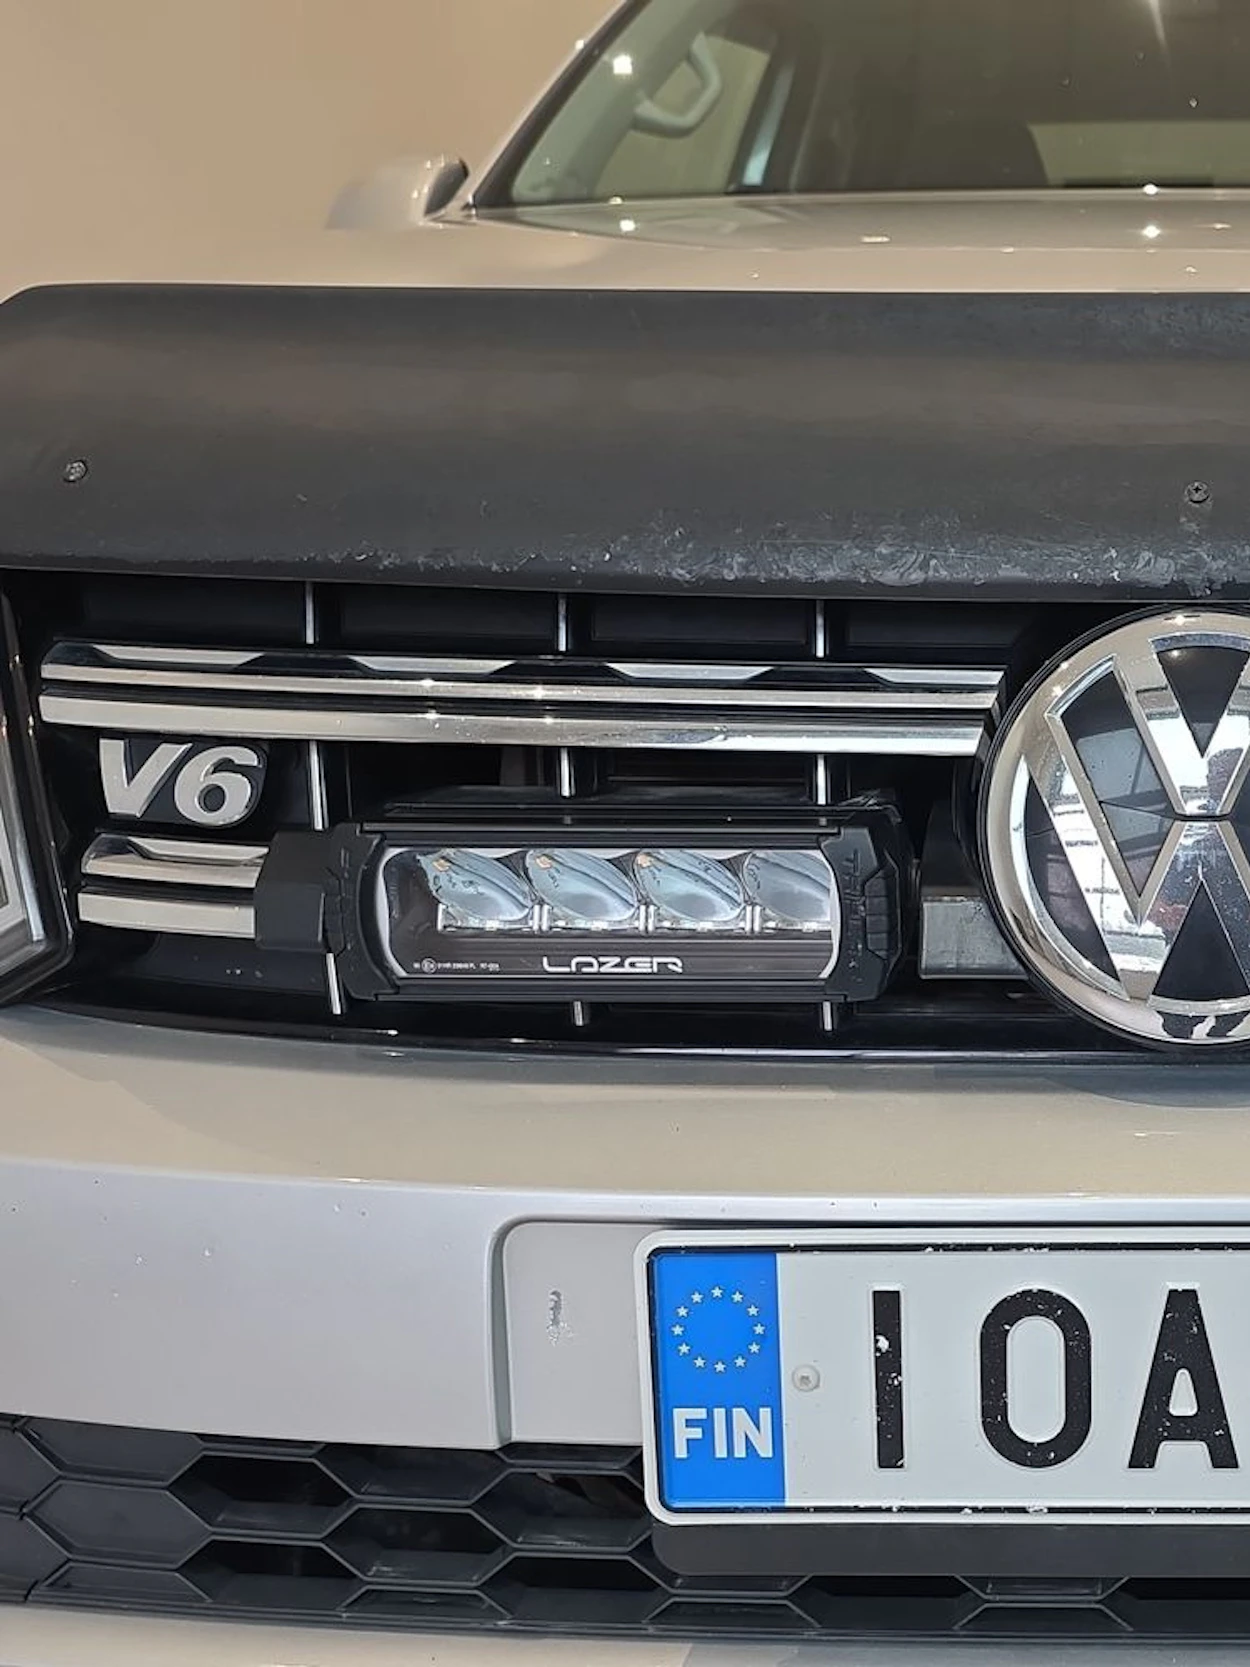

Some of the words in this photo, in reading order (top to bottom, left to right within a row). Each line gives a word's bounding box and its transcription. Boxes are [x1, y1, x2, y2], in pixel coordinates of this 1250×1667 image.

[98, 737, 262, 827] V6
[542, 956, 684, 973] LAZER
[671, 1406, 774, 1460] FIN
